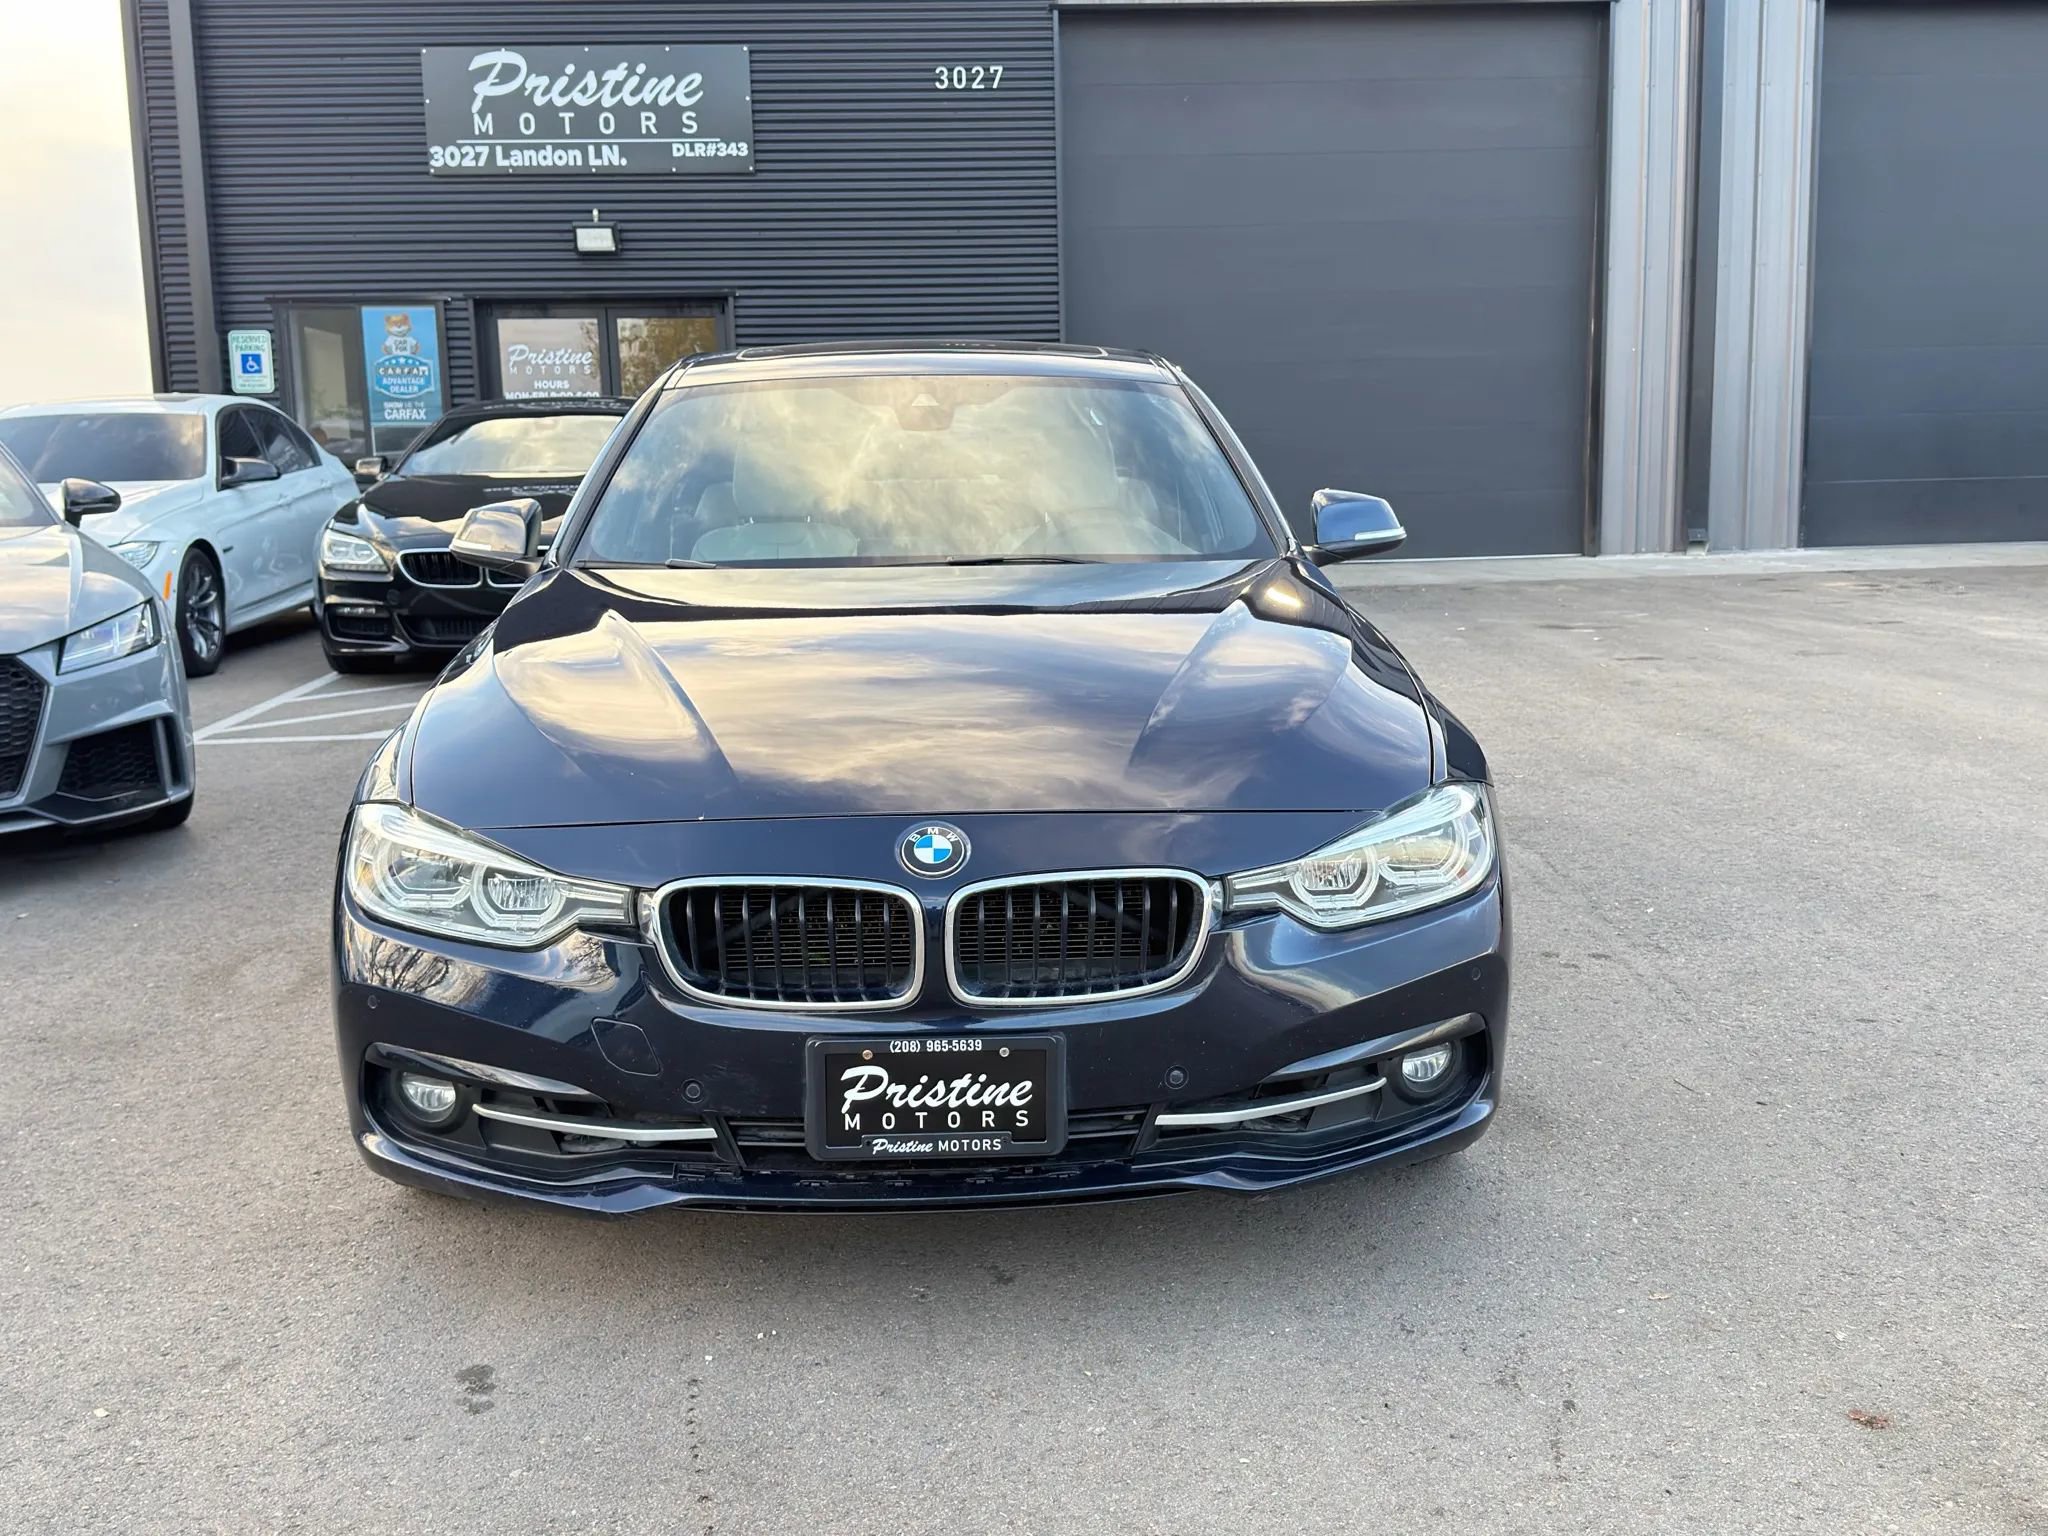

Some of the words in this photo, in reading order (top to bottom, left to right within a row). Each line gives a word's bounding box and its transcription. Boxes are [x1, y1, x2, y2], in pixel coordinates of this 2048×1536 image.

[468, 50, 704, 113] Pristine
[934, 65, 1003, 89] 3027
[473, 112, 698, 135] MOTORS
[430, 145, 489, 167] 3027
[496, 145, 582, 167] Landon
[588, 145, 628, 167] LN.
[672, 142, 748, 157] DLR#343
[235, 344, 265, 352] PARKING
[508, 344, 593, 368] Pristine
[509, 364, 592, 374] MOTORS
[382, 377, 424, 385] ADVANTAGE
[534, 380, 570, 389] HOURS
[390, 385, 419, 393] DEALER
[384, 409, 426, 420] CARFAX
[908, 827, 959, 842] BMW
[889, 1040, 921, 1053] (208)
[926, 1039, 983, 1052] 965-5639
[840, 1065, 1033, 1114] Pristine
[844, 1110, 1029, 1130] MOTORS
[872, 1138, 934, 1155] Pristine
[938, 1138, 1002, 1151] MOTORS
